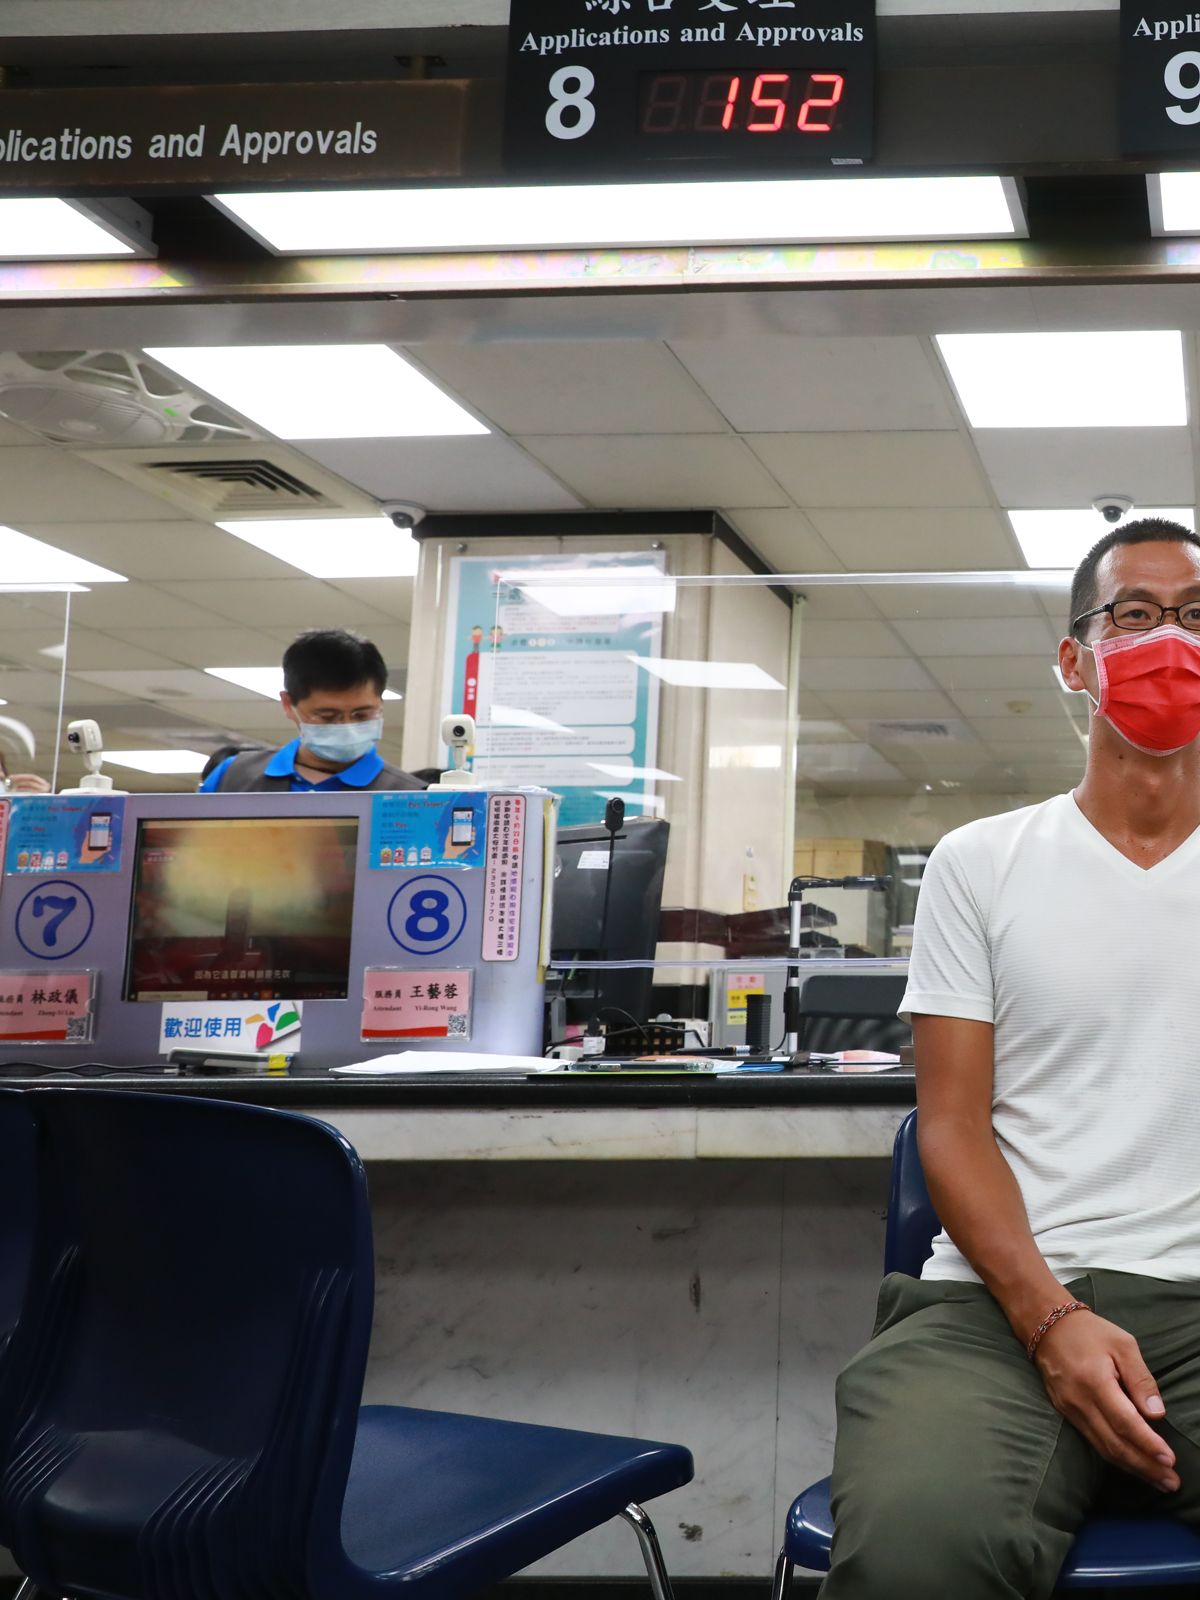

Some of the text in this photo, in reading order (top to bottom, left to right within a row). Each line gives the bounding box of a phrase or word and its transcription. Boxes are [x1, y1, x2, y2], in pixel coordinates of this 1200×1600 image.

[519, 22, 864, 55] Applications and Approvals
[545, 65, 596, 140] 8
[721, 73, 845, 132] 152
[149, 125, 205, 159] and
[219, 121, 378, 164] Approvals
[32, 895, 77, 947] 7
[405, 889, 450, 942] 8
[409, 983, 459, 999] 王藝蓉
[164, 1017, 242, 1038] 歡迎使用
